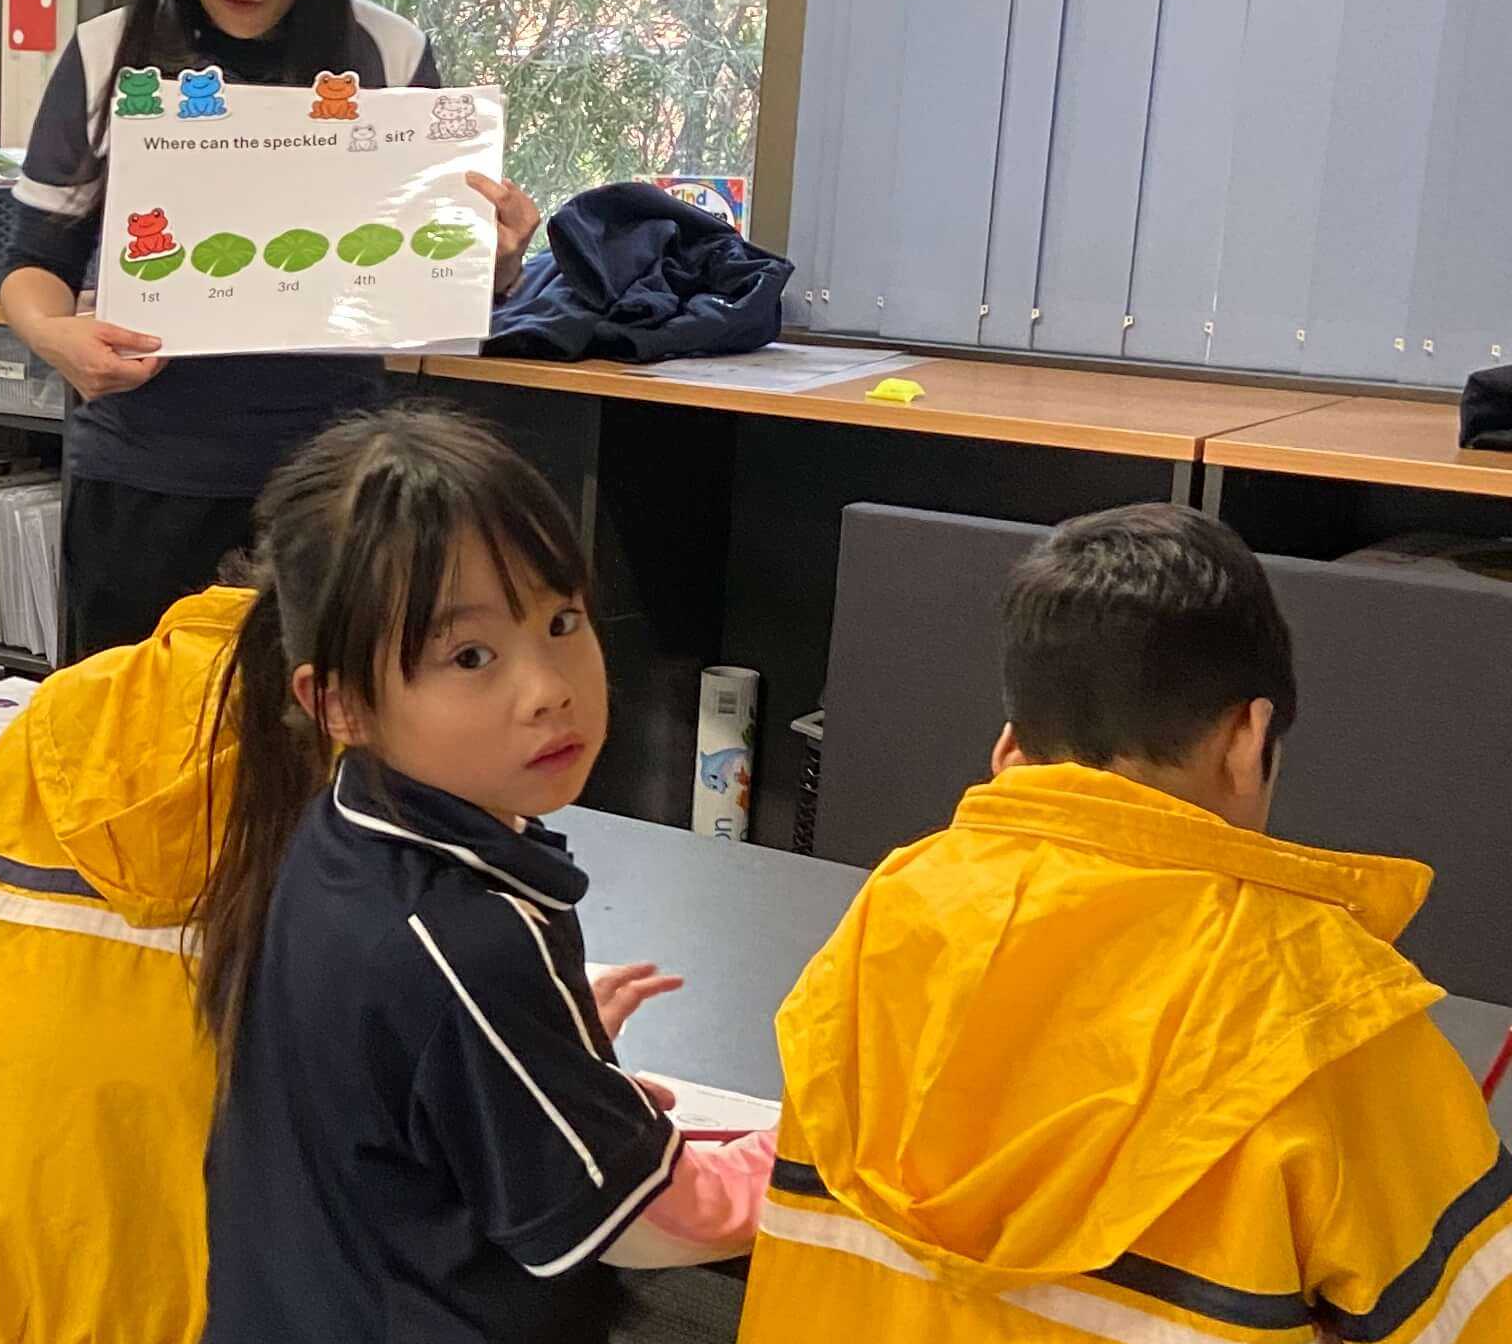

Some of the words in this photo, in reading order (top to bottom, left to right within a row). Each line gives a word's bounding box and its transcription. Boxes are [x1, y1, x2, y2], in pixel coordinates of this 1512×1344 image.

[143, 137, 196, 150] Where
[200, 139, 229, 150] can
[234, 136, 259, 149] the
[263, 133, 337, 150] speckled
[385, 129, 415, 143] sit?
[431, 266, 454, 279] 5th
[353, 274, 377, 286] 4th
[277, 280, 300, 293] 3rd
[141, 292, 161, 303] 1st
[208, 287, 234, 299] 2nd
